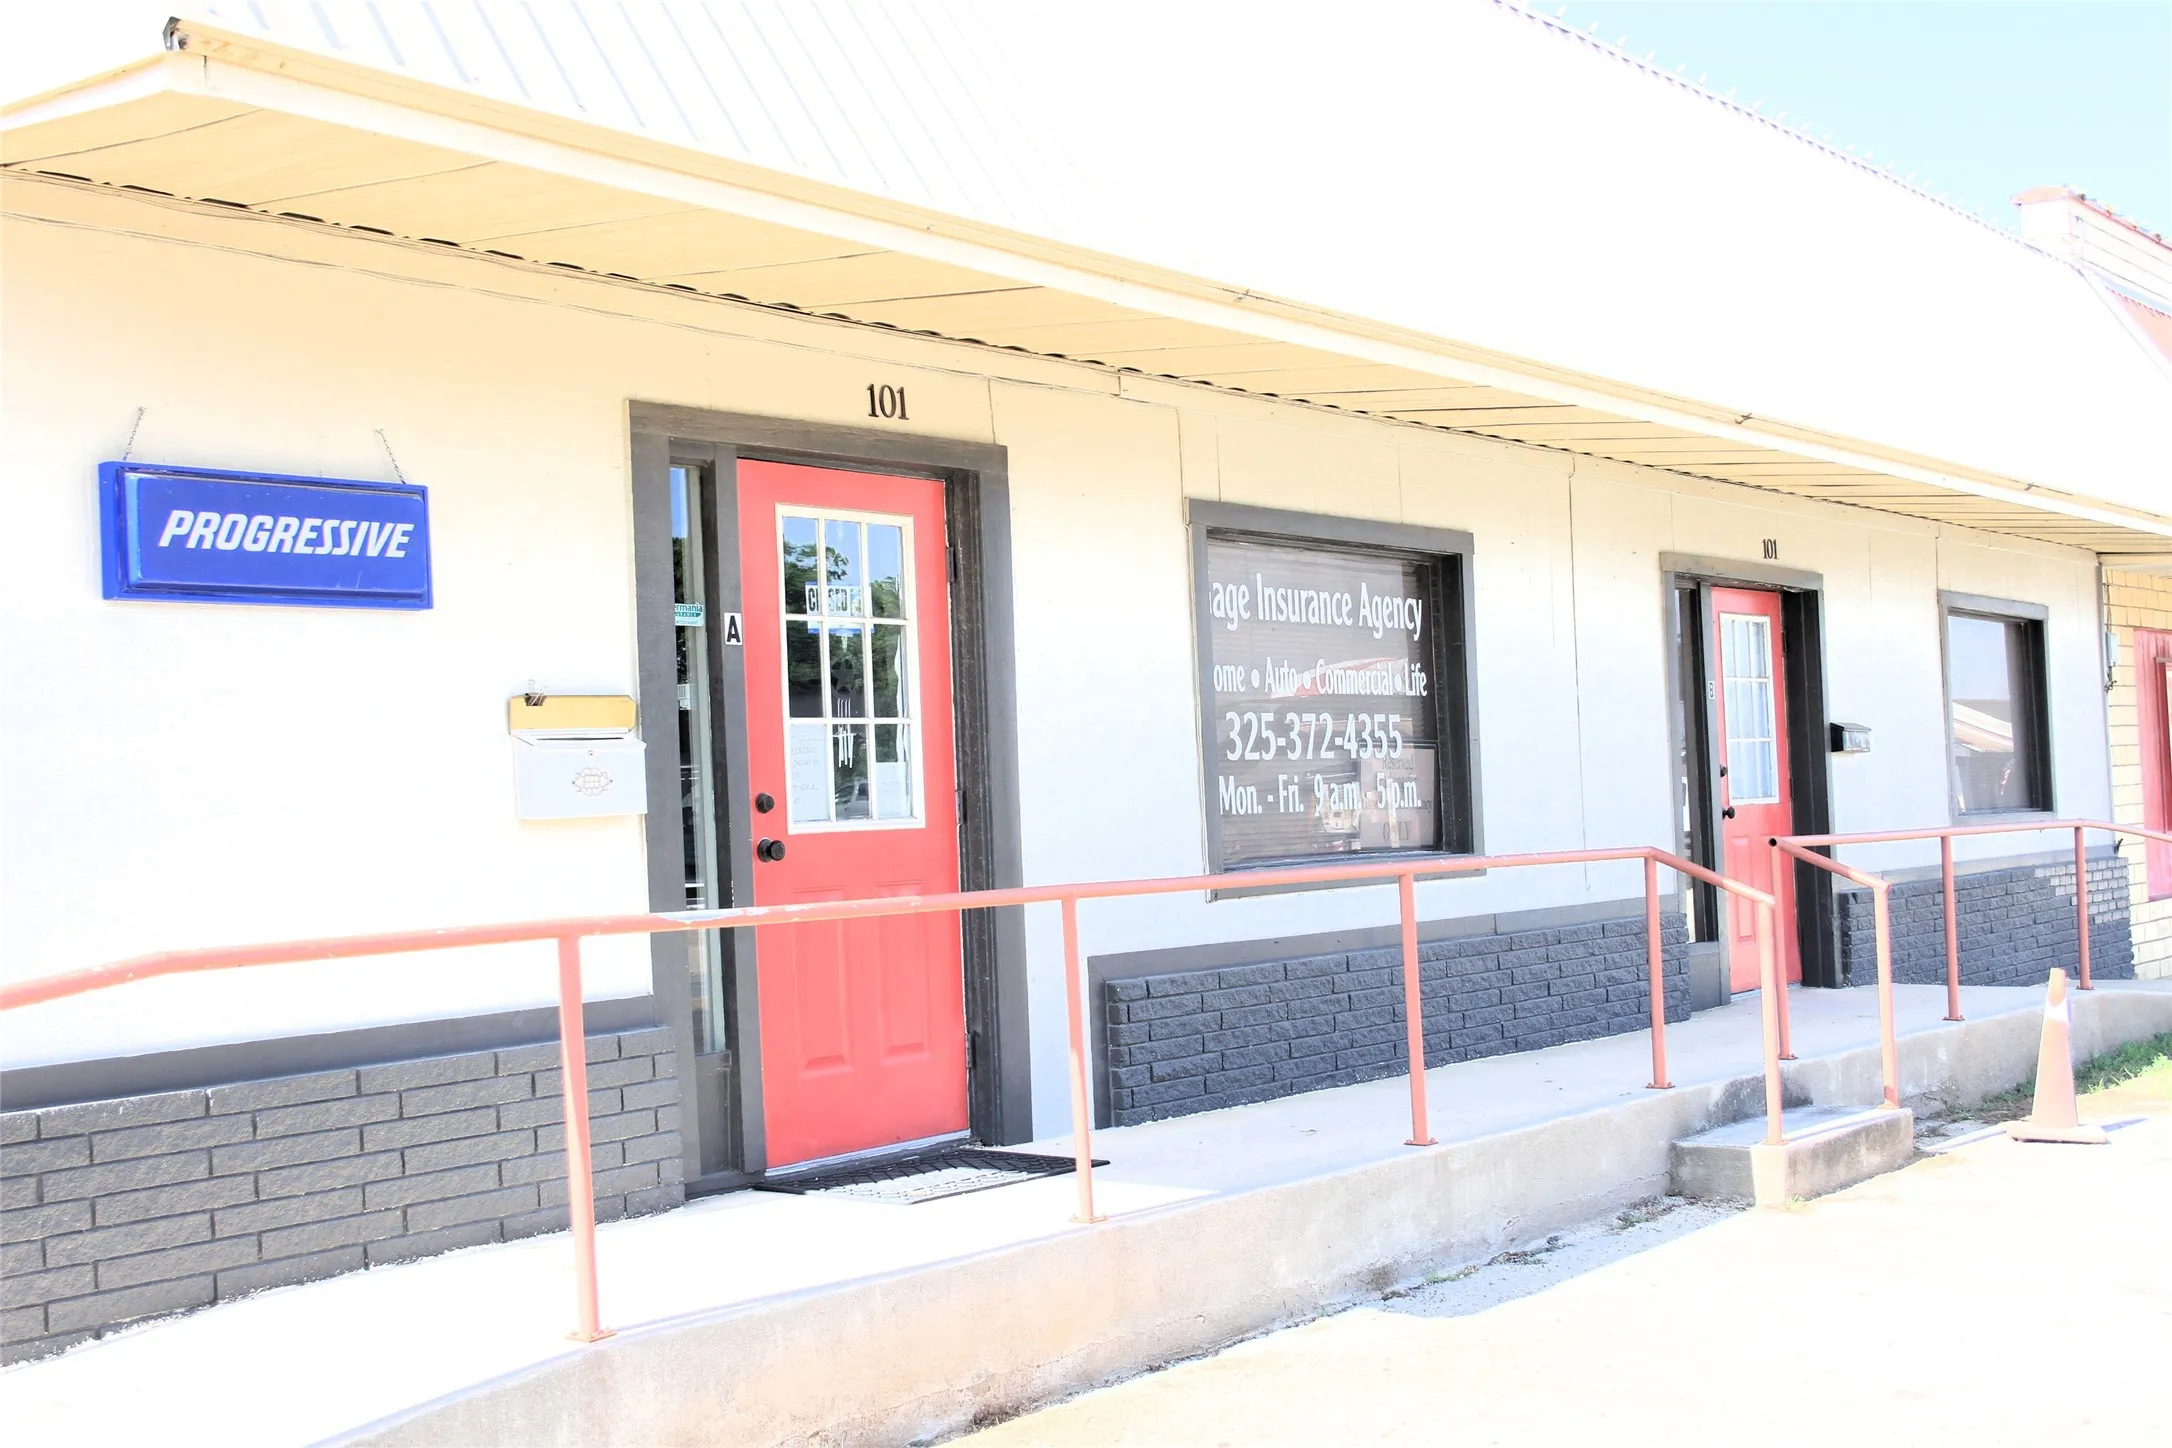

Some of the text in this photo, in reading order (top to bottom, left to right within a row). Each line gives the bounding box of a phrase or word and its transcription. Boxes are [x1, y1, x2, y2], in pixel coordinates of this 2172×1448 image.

[867, 383, 910, 420] 101
[158, 510, 415, 558] PROGRESSIVE
[1762, 538, 1779, 560] 101
[1209, 573, 1422, 641] age Insurance Agency
[727, 615, 741, 643] A
[1213, 656, 1428, 697] ome Auto Commercial Life
[1225, 711, 1402, 761] 325-372-4355
[1218, 775, 1263, 815] Mon.
[1278, 774, 1304, 813] Fri.
[1313, 773, 1324, 817] 9
[1330, 781, 1363, 811] a.m.
[1376, 772, 1386, 809] 5
[1391, 781, 1422, 815] p.m.
